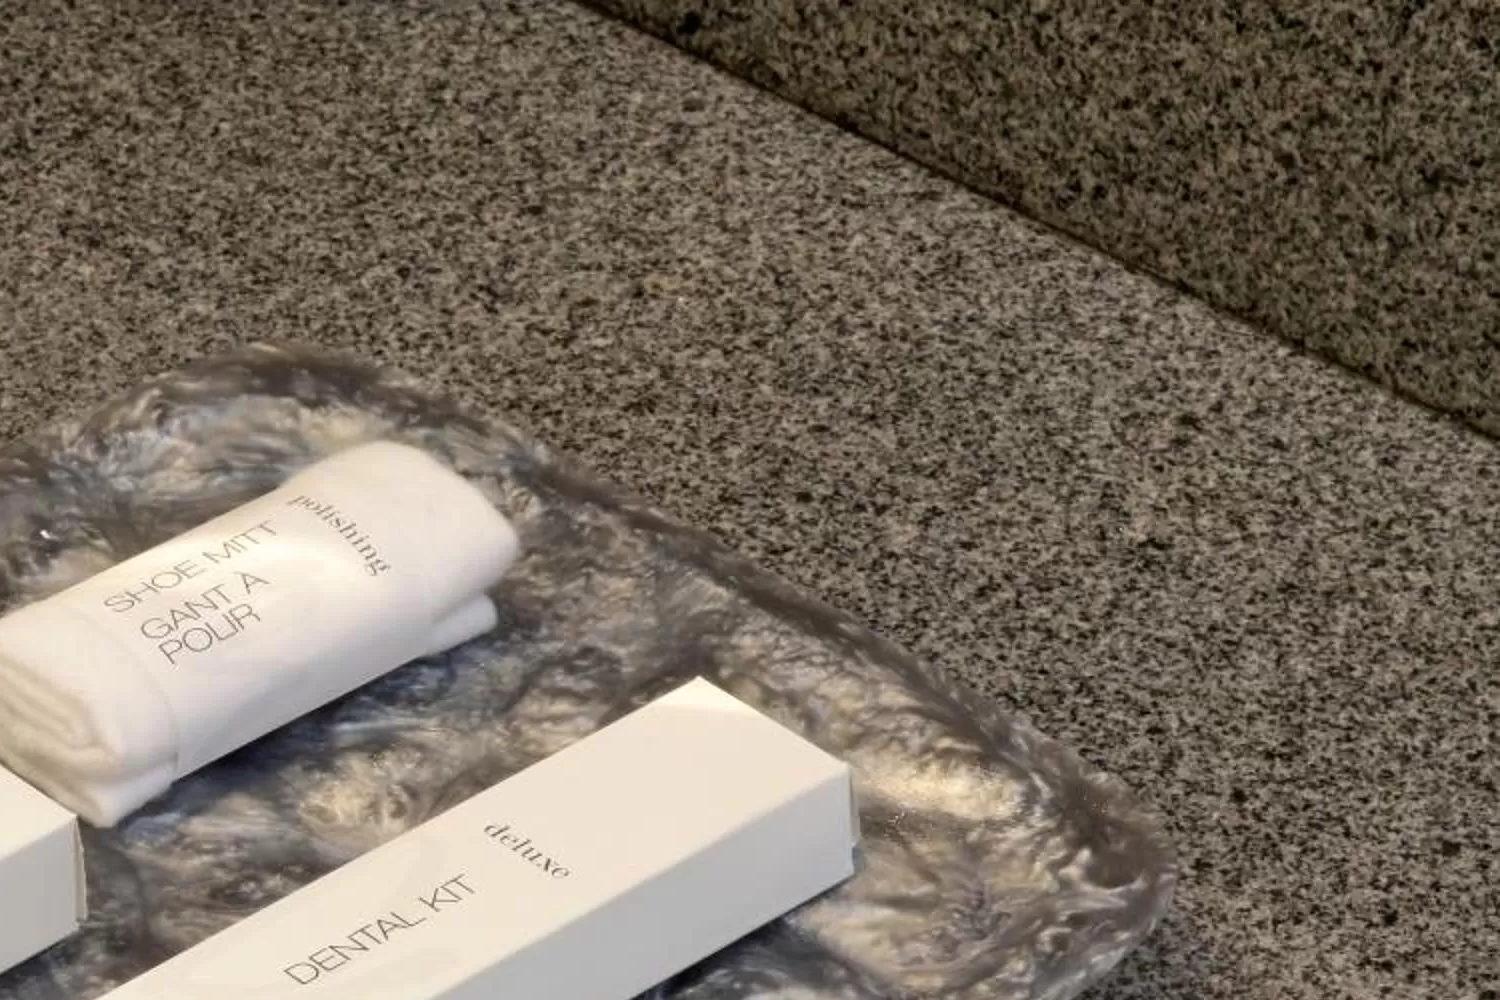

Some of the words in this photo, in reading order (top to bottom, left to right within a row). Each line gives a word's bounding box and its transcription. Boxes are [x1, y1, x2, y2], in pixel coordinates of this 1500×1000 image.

[102, 559, 204, 613] SHOE
[201, 519, 278, 565] MITT
[286, 494, 392, 577] polishing
[140, 583, 232, 640] GANT
[233, 570, 271, 595] A
[157, 602, 262, 665] POUR
[483, 821, 570, 880] deluxe
[283, 909, 427, 986] DENTAL
[418, 872, 478, 914] KIT
